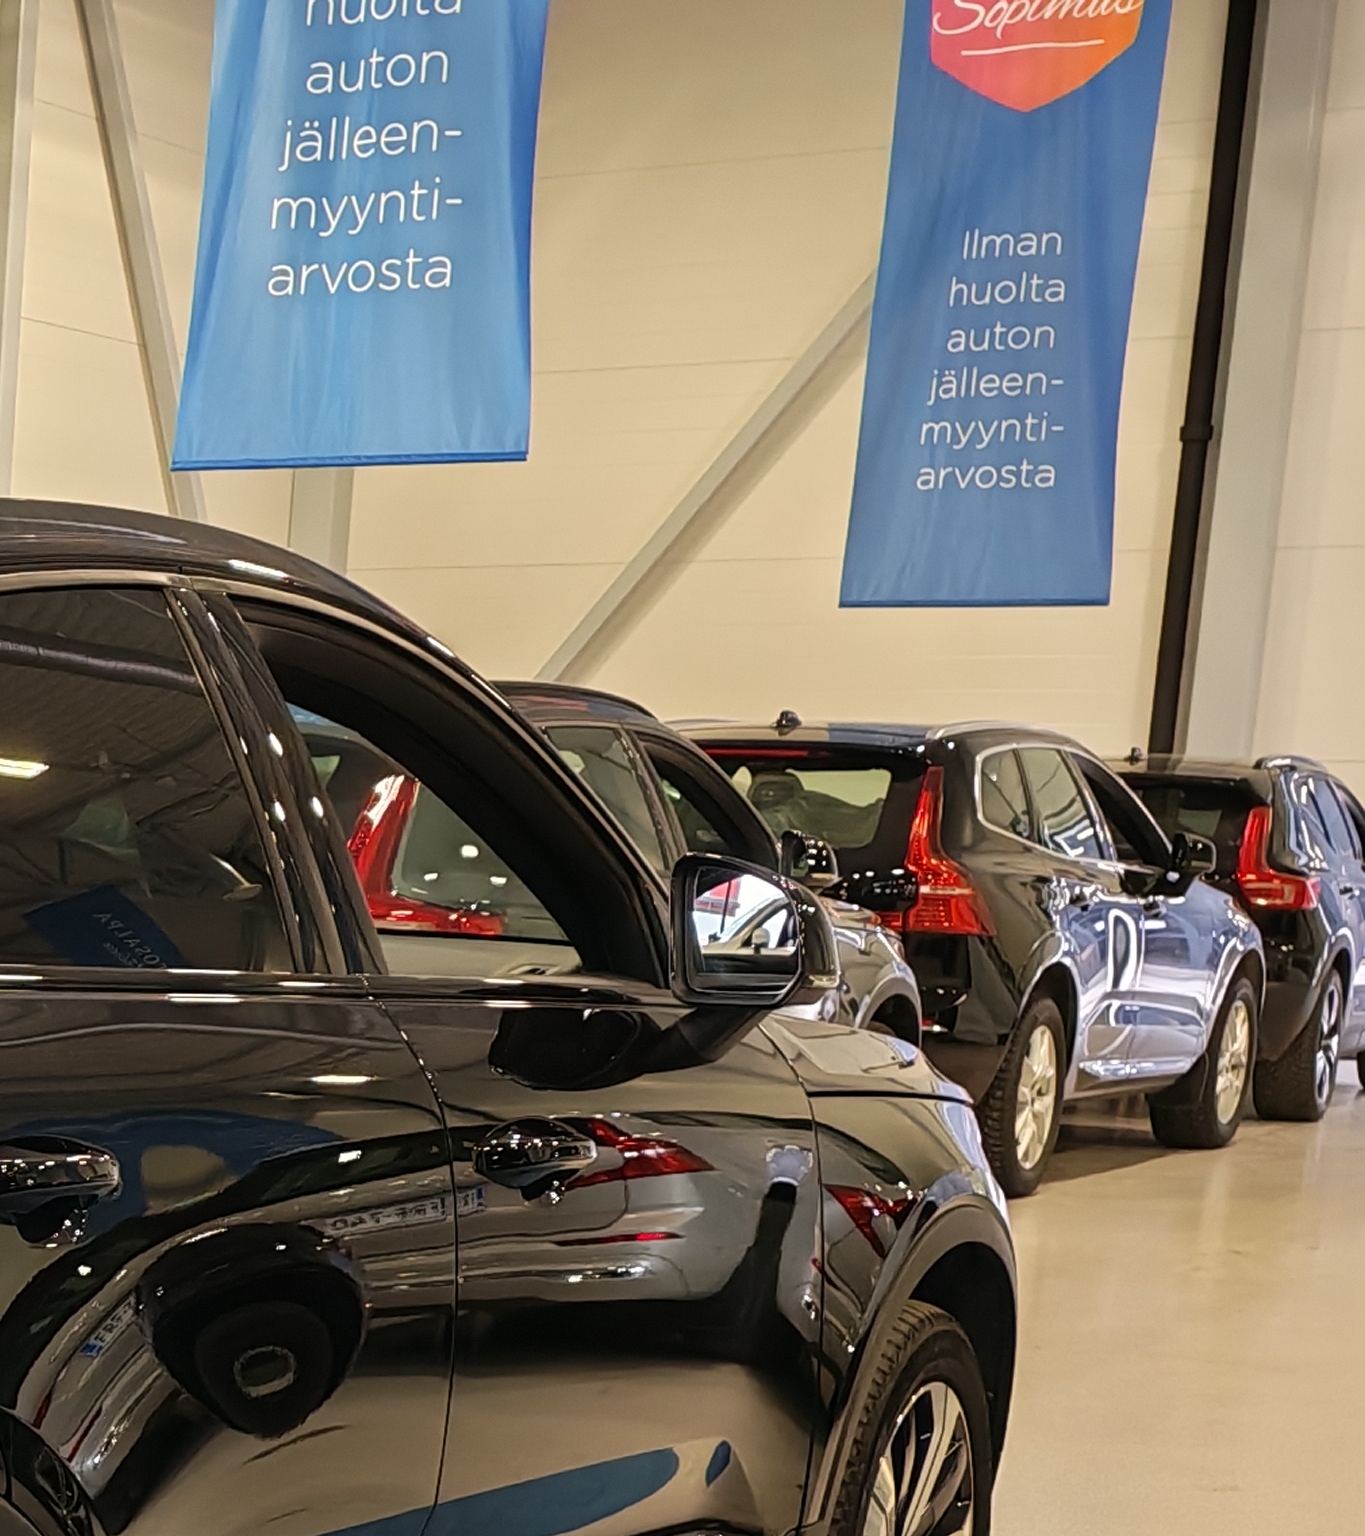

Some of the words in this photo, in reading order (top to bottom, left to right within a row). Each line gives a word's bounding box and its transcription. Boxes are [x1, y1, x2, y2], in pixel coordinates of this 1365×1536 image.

[306, 48, 448, 94] auton
[277, 116, 462, 172] jälleen-
[270, 176, 463, 237] myynti-
[963, 228, 1062, 260] Ilman
[267, 248, 452, 296] arvosta
[949, 271, 1066, 307] huolta
[947, 321, 1055, 353] auton
[926, 366, 1064, 406] jälleen-
[920, 411, 1064, 450] myynti-
[916, 458, 1056, 491] arvosta
